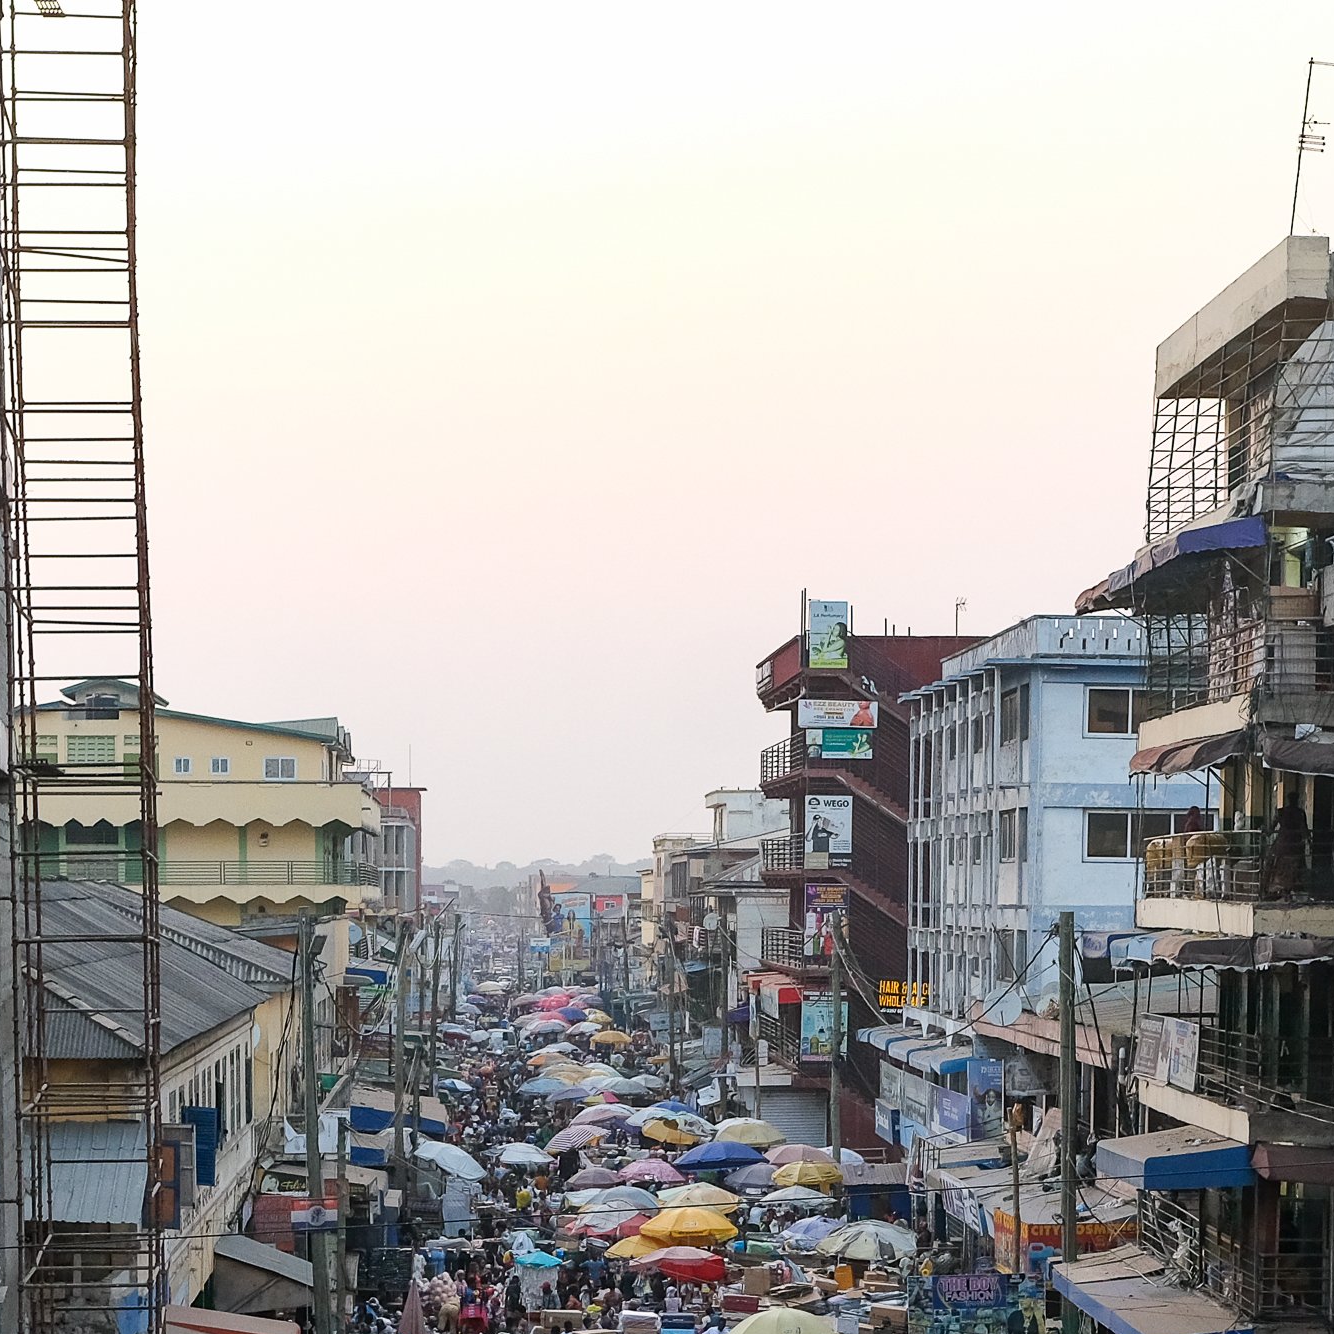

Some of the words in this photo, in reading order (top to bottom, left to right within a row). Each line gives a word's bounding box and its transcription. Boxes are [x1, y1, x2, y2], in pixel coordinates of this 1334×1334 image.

[823, 799, 849, 808] WEGO
[879, 980, 900, 994] HAIR
[1031, 1224, 1061, 1236] CITY
[940, 1277, 967, 1292] THE
[969, 1276, 999, 1291] BOY
[945, 1291, 995, 1302] FASHION
